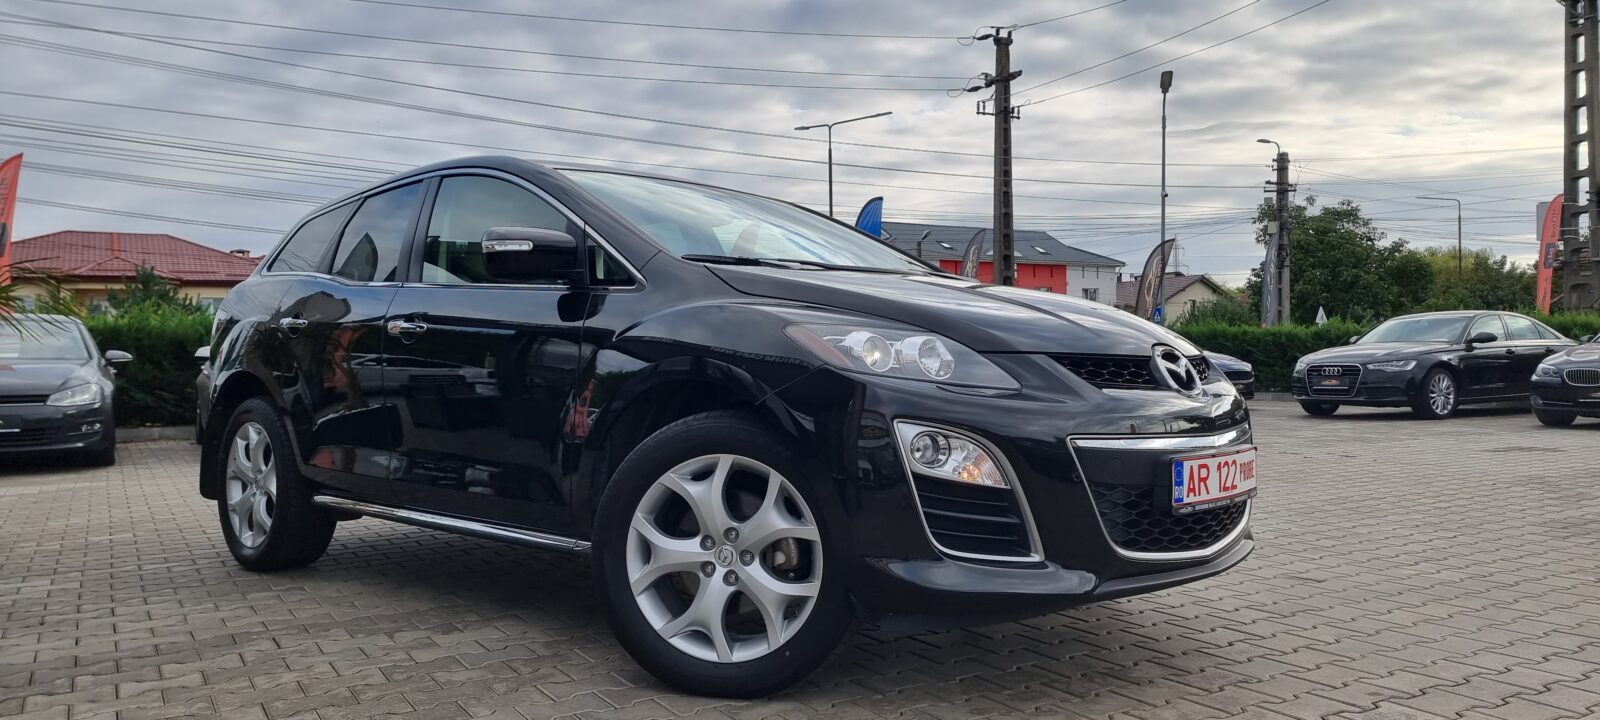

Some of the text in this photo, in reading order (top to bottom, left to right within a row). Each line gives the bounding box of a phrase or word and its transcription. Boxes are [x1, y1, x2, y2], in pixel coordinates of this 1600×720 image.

[1186, 463, 1210, 498] AR
[1216, 459, 1238, 493] 122
[1174, 486, 1184, 499] RO
